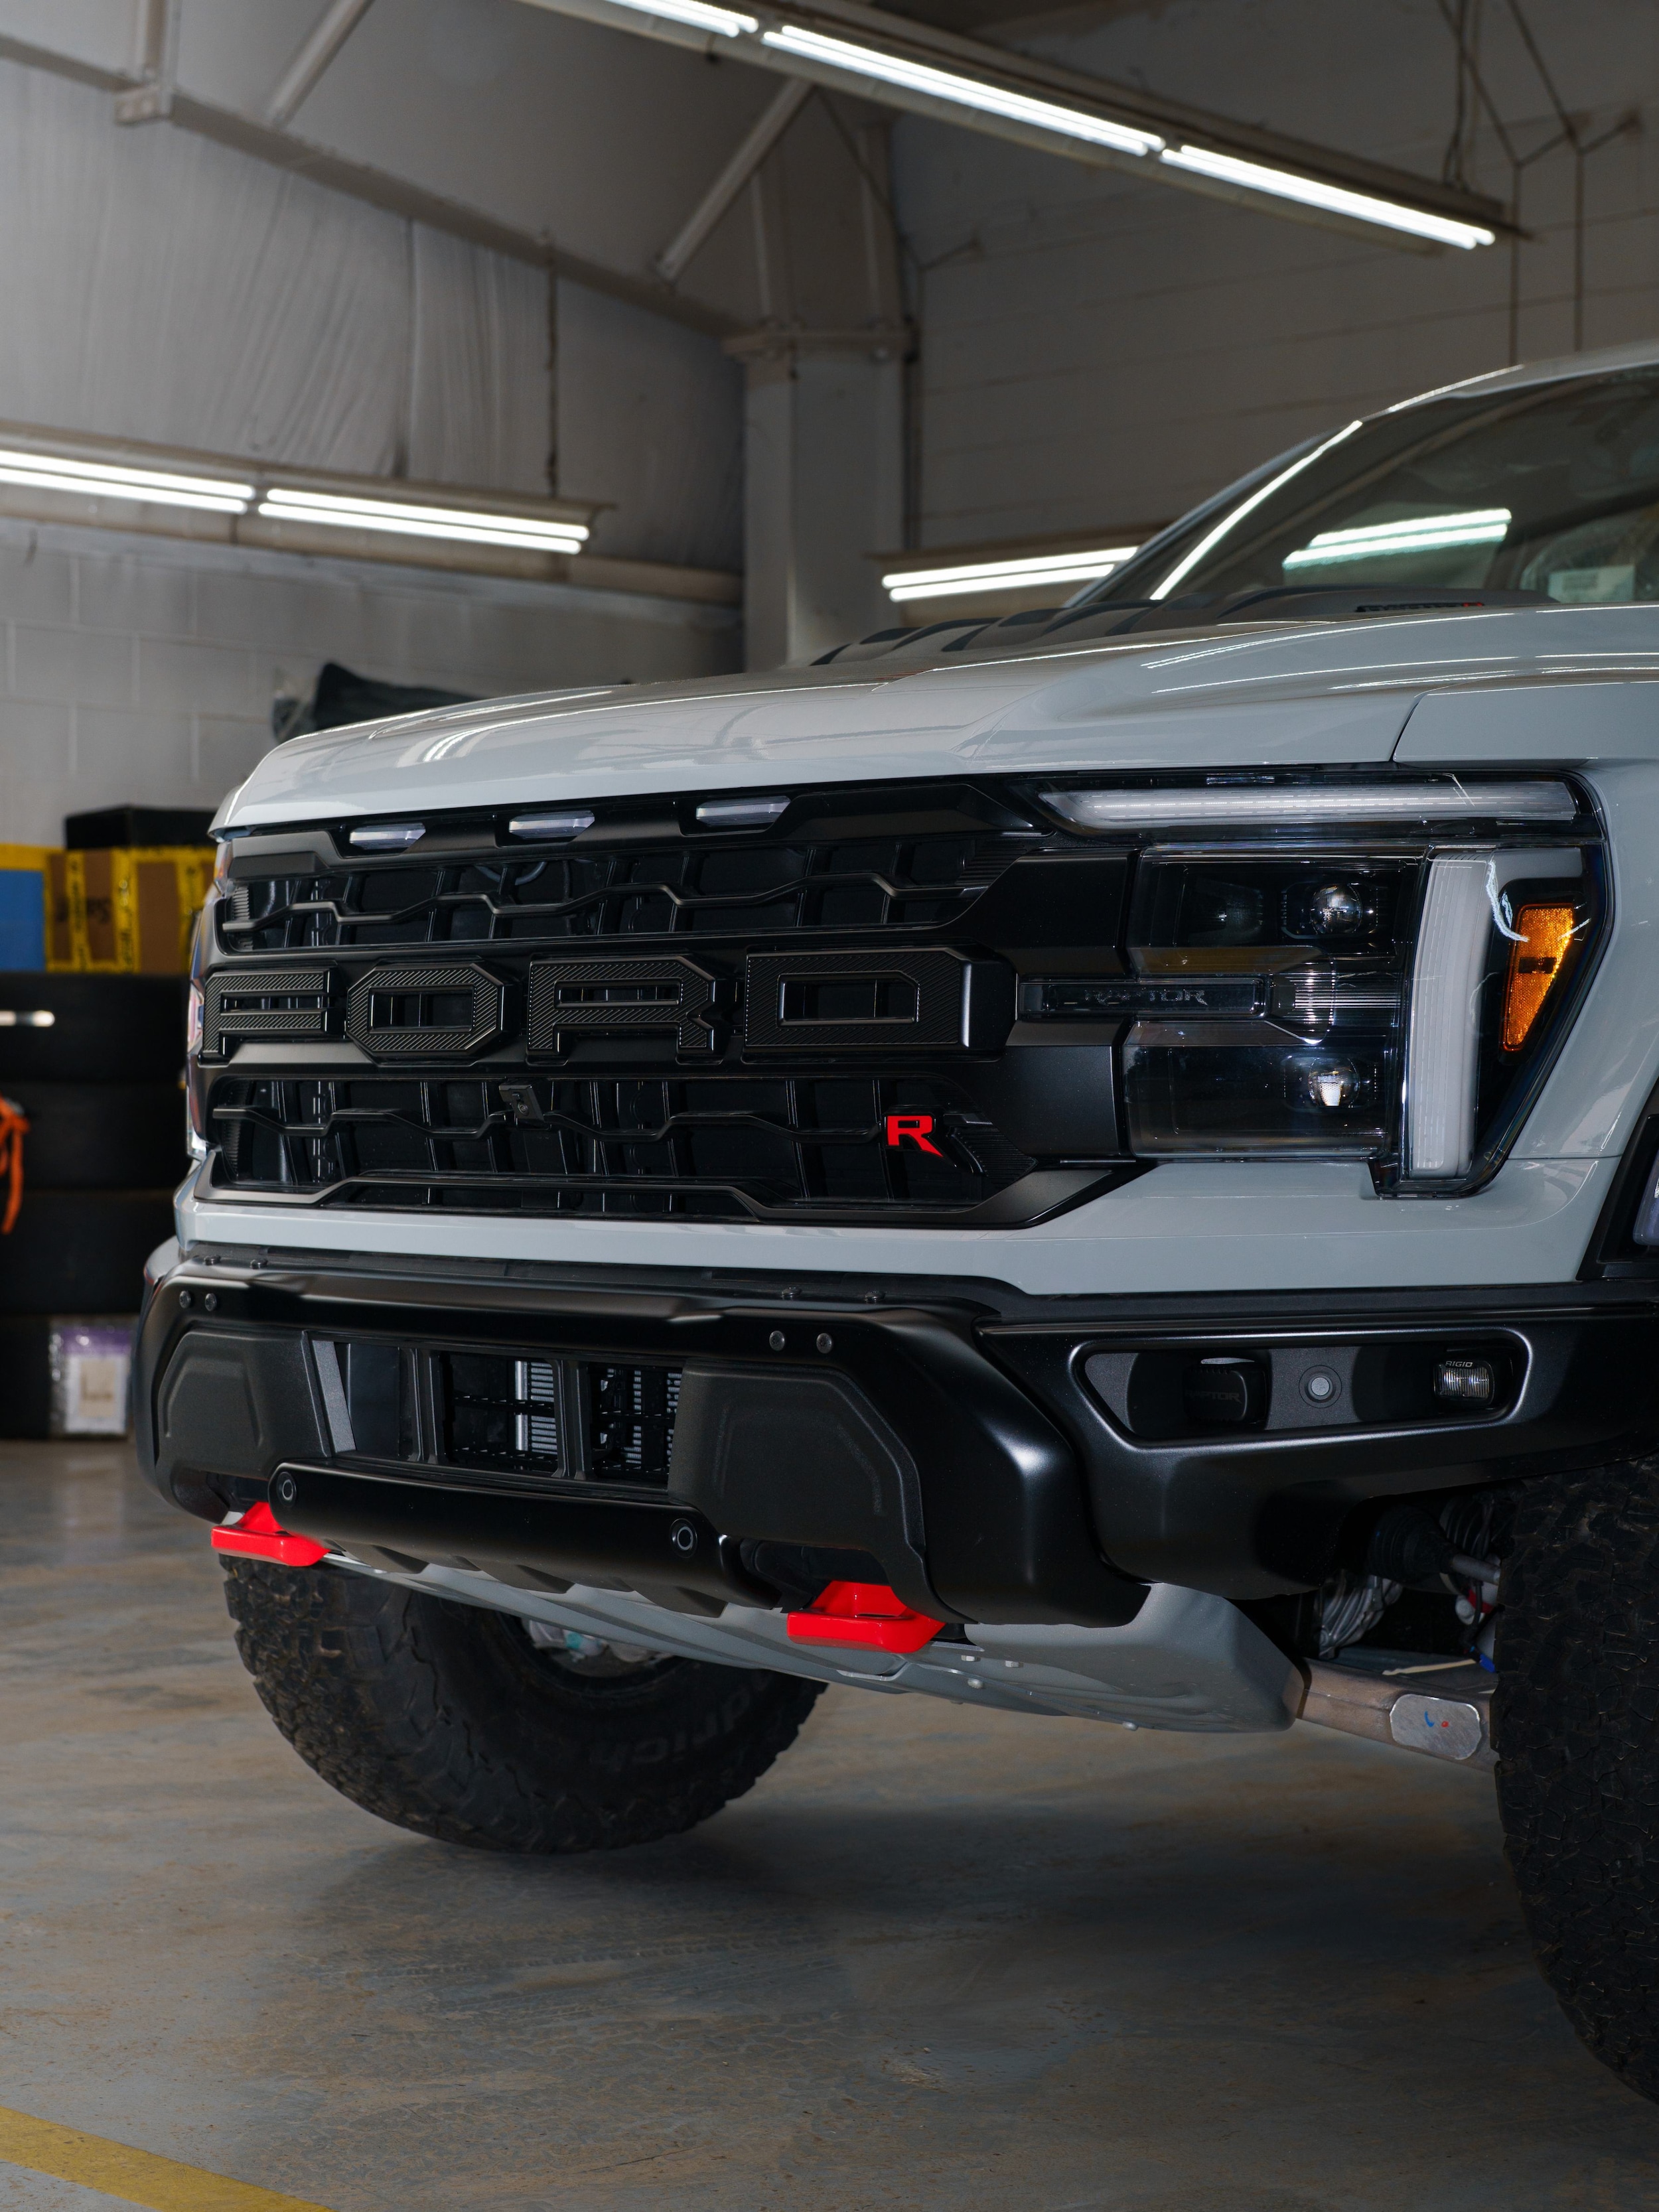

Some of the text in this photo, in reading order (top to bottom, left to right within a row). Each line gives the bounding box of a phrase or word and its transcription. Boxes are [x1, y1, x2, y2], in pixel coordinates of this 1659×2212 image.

[202, 947, 973, 1060] FORD
[887, 1115, 944, 1158] R
[1184, 1389, 1243, 1405] RAPTOR
